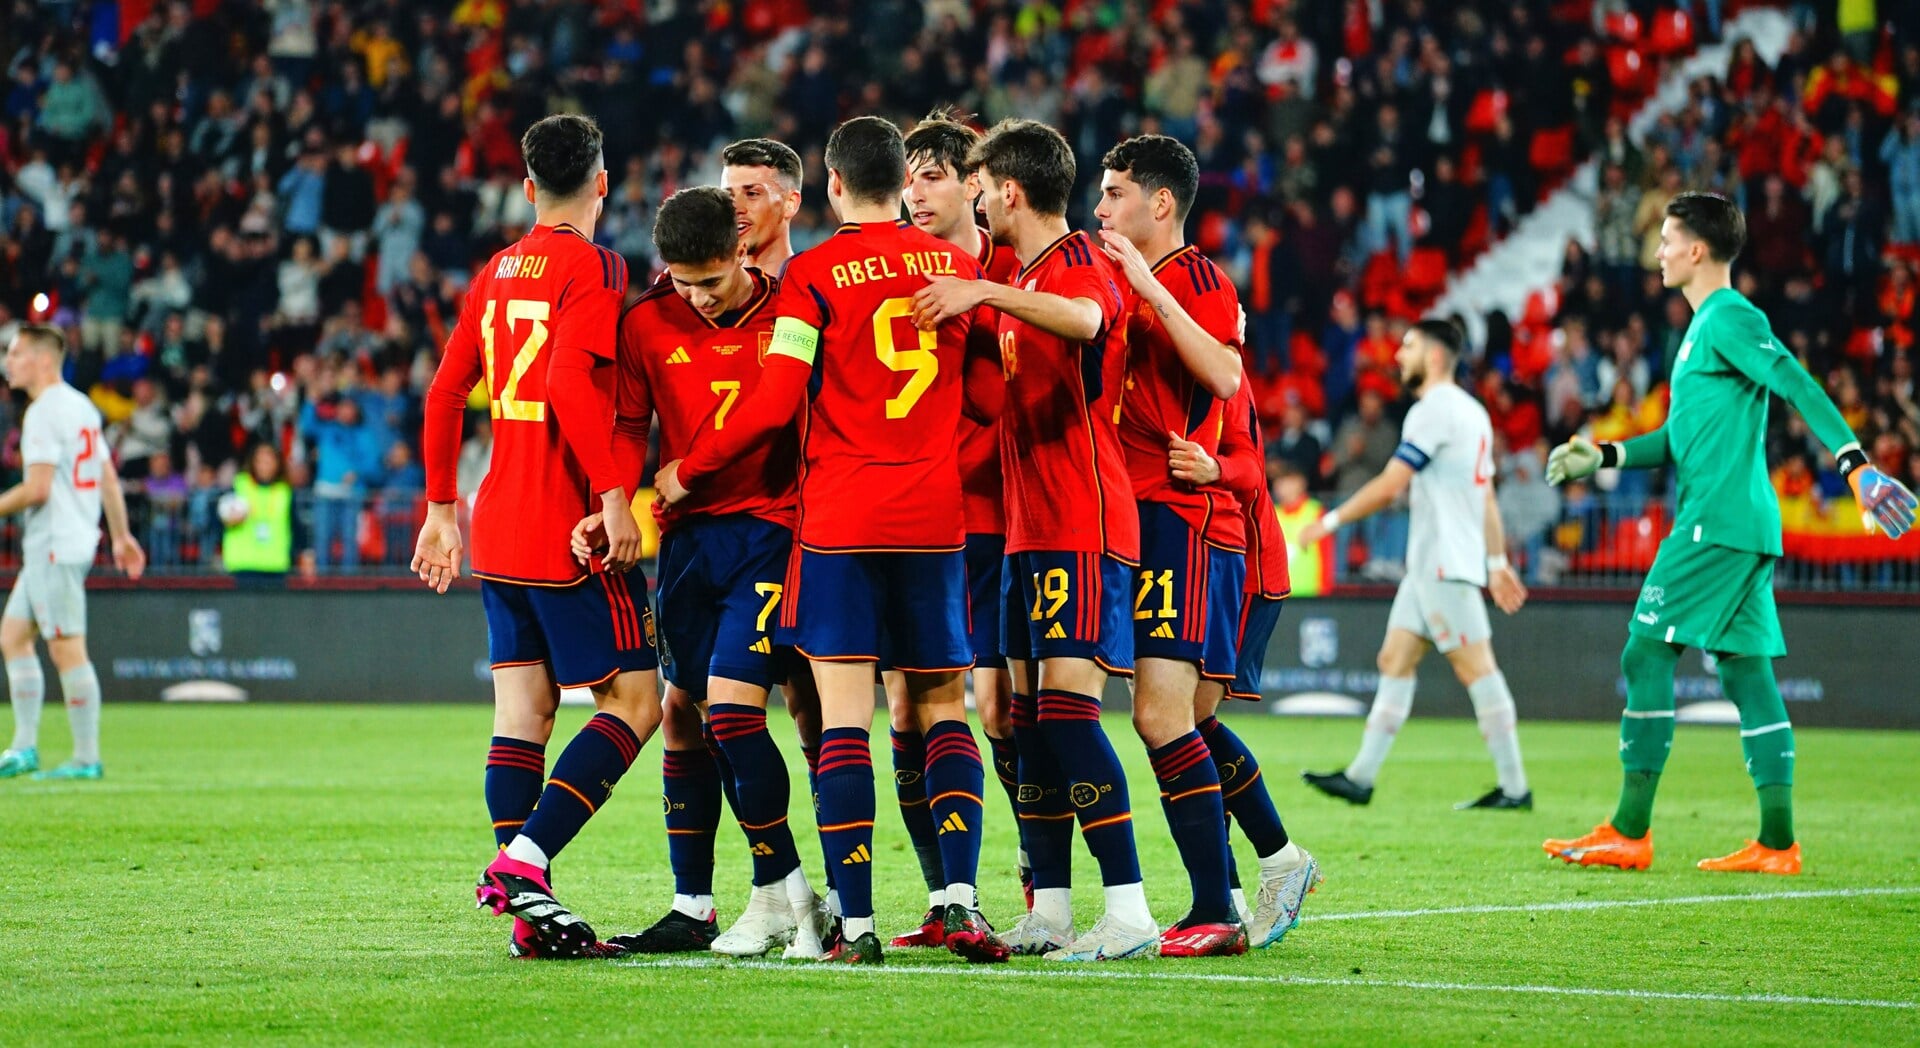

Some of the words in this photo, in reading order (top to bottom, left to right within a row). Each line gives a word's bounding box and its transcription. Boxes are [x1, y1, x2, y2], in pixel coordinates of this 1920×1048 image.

[495, 255, 548, 279] ARNAU
[831, 256, 897, 289] ABEL
[902, 252, 957, 275] RUIZ
[480, 299, 550, 422] 12
[782, 332, 815, 349] RESPECT
[873, 297, 939, 420] 9
[711, 381, 740, 431] 7
[755, 582, 783, 632] 7
[1030, 568, 1069, 621] 19
[1133, 569, 1177, 621] 21
